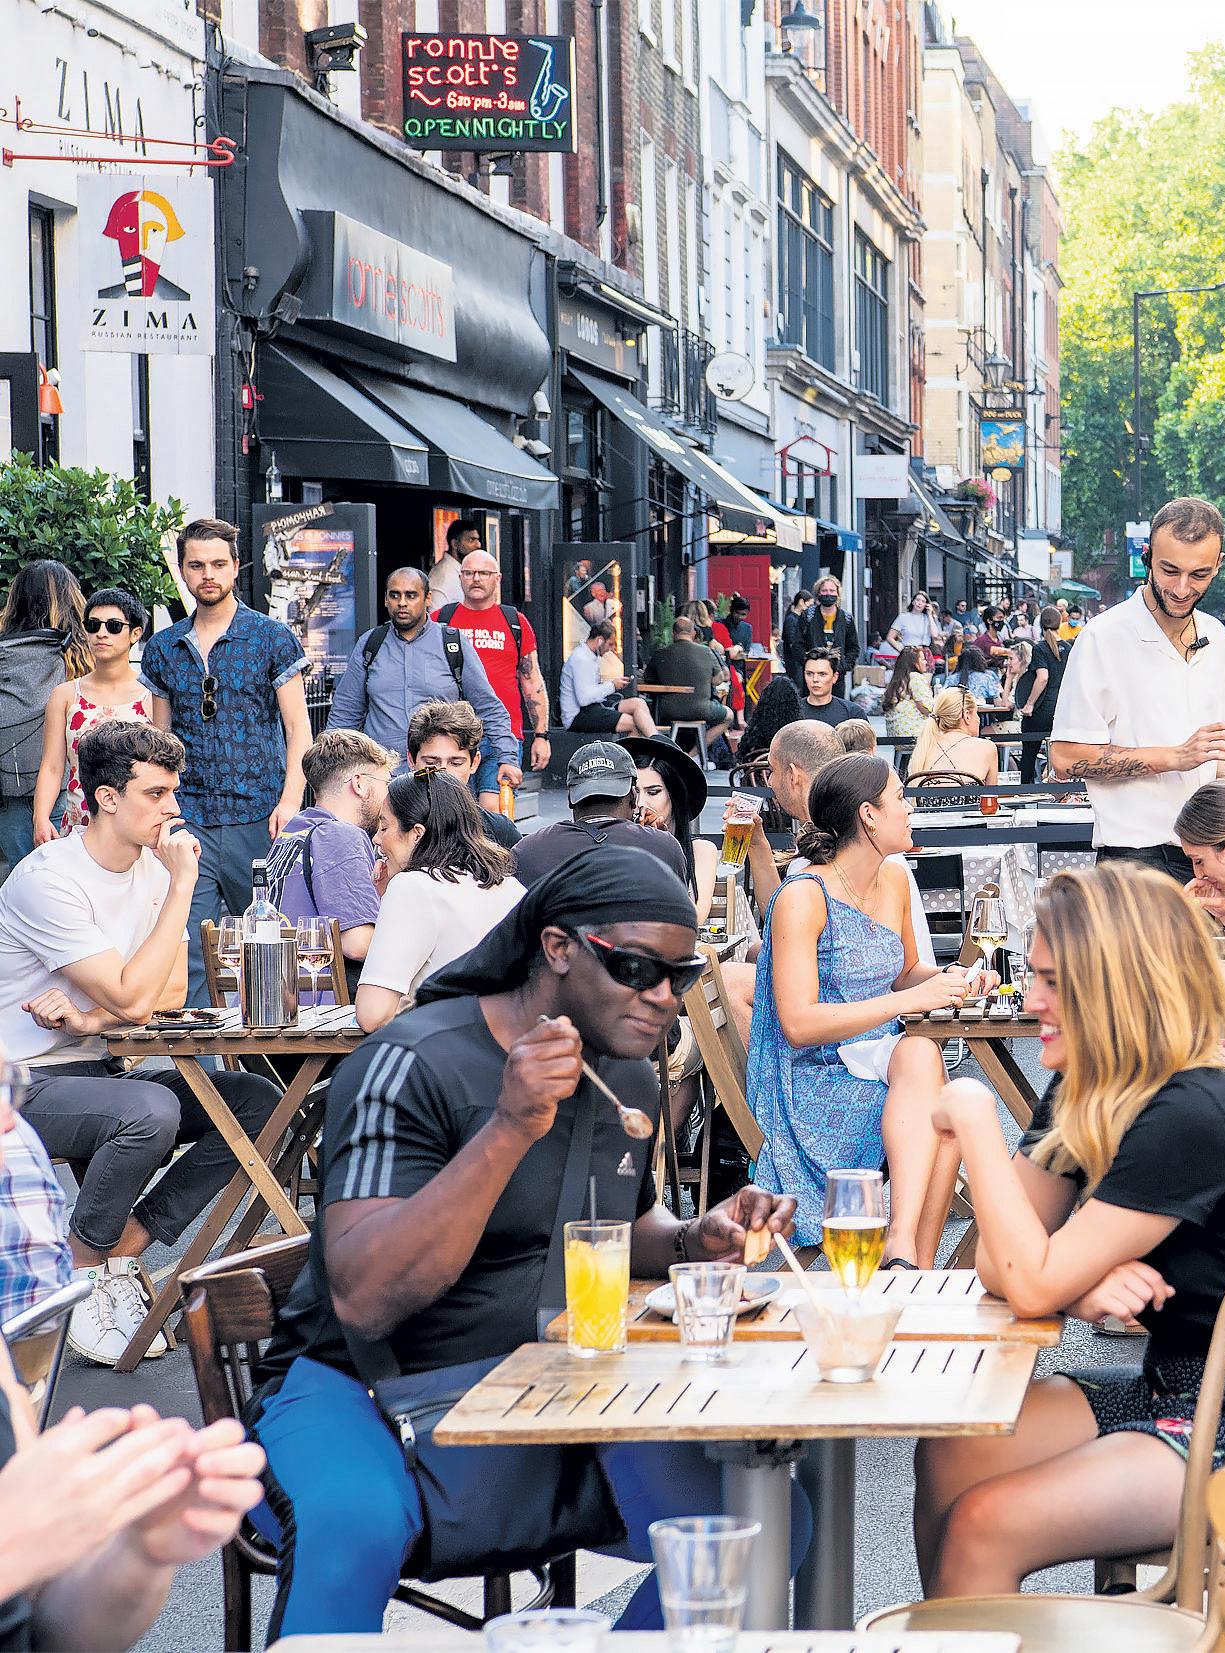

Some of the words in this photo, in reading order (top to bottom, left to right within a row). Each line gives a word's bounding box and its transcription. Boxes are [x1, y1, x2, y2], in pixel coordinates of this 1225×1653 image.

[407, 37, 520, 60] ronnie
[408, 61, 517, 86] scott's
[56, 57, 146, 157] ZIMA
[404, 117, 470, 138] OPEN
[472, 117, 567, 139] NIGHTLY
[92, 308, 197, 330] ZIMA
[91, 331, 132, 339] RUSSIAN
[137, 333, 198, 341] RESTAURANT
[270, 505, 327, 533] РЮМОЧНАЯ
[578, 760, 589, 775] LOS
[588, 757, 615, 770] ANGELES
